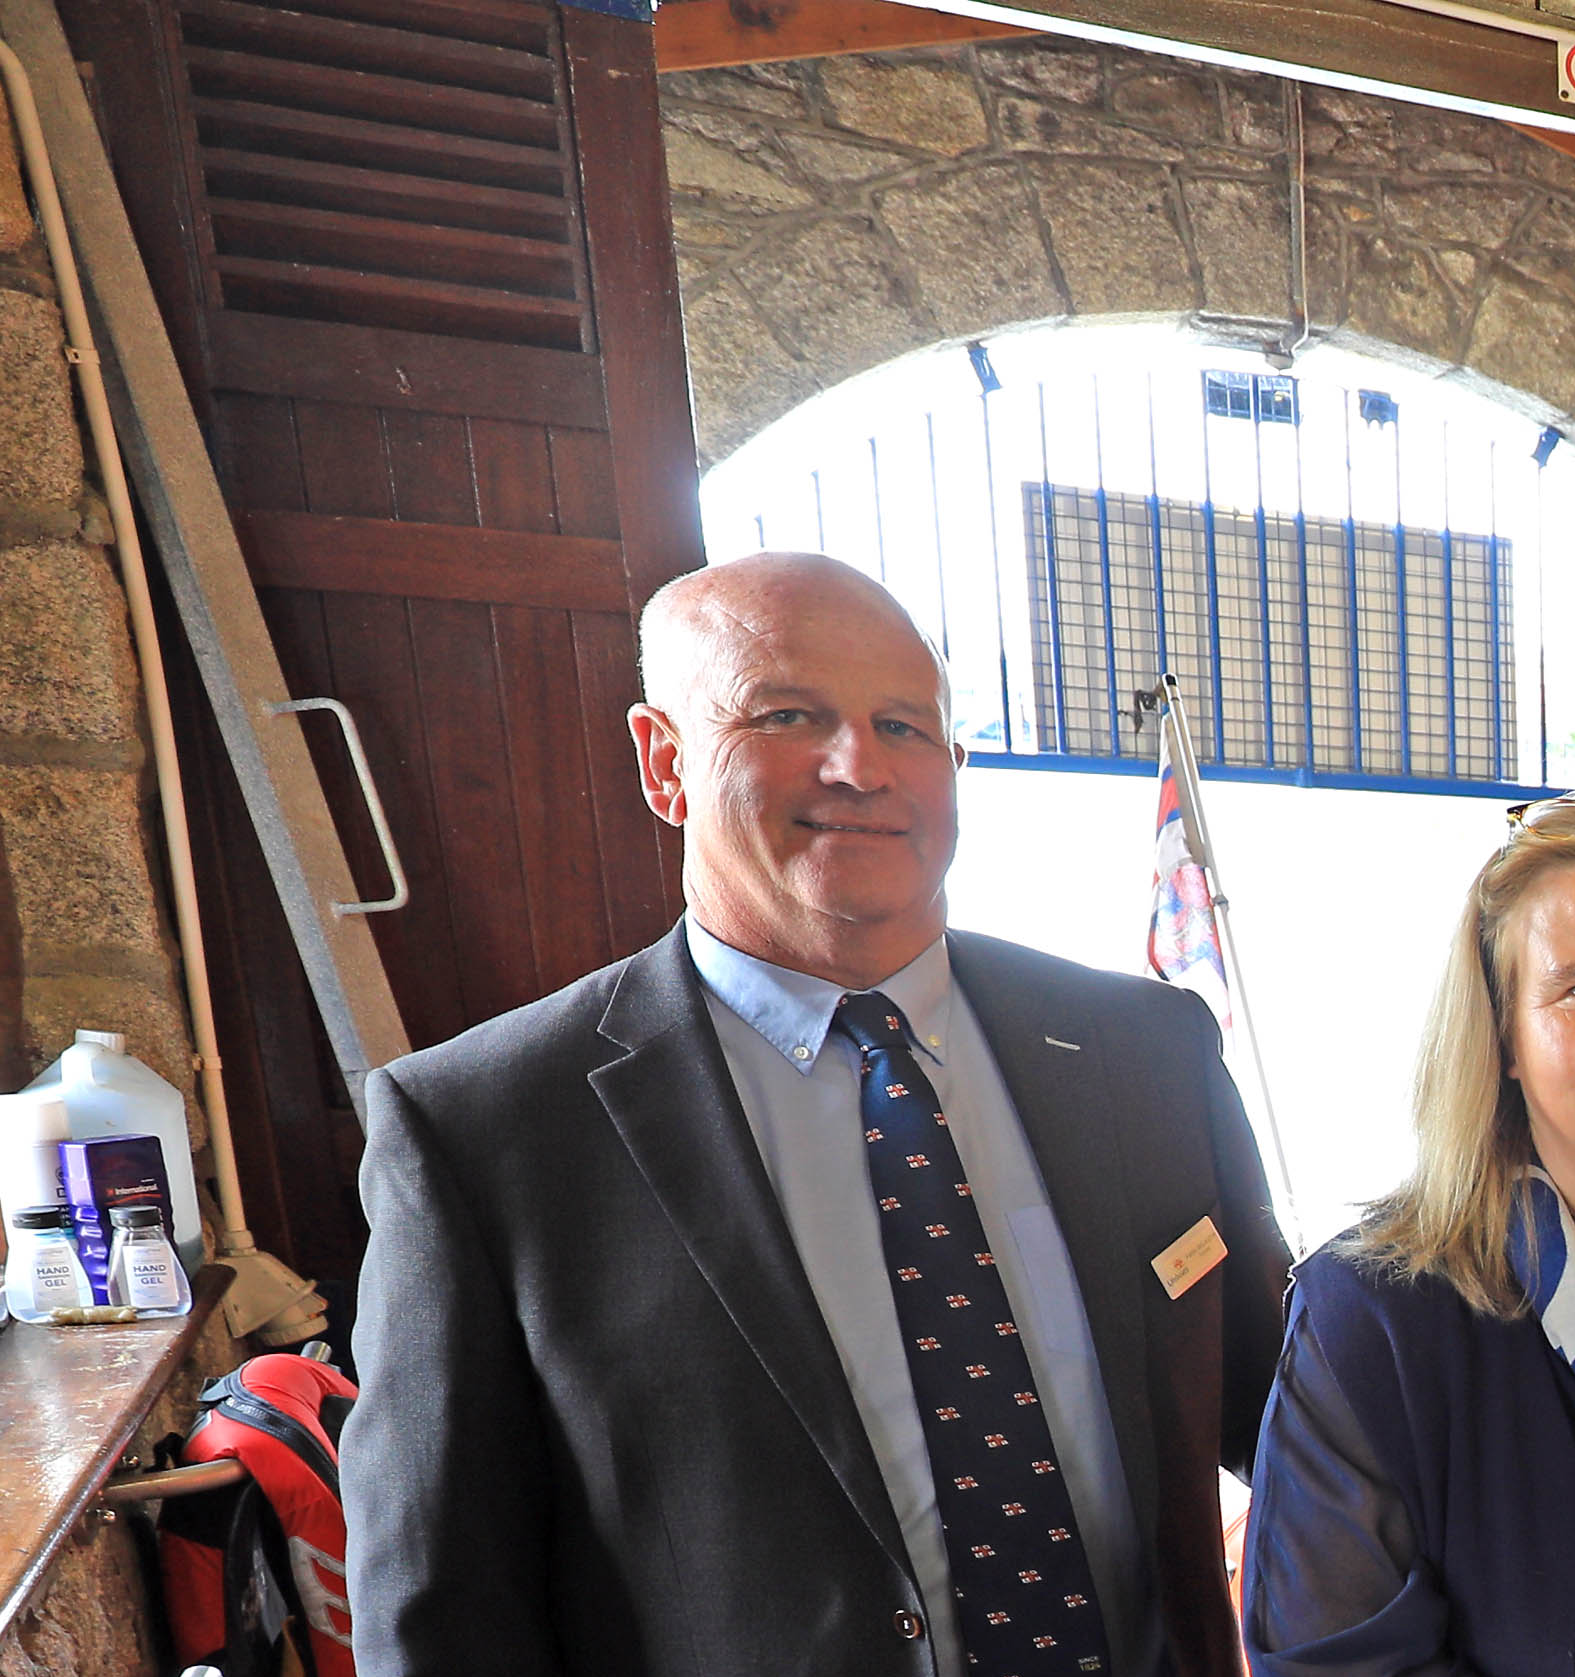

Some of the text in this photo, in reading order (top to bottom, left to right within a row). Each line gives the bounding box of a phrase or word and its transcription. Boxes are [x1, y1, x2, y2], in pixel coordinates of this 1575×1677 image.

[36, 1266, 70, 1275] HAND
[133, 1264, 166, 1273] HAND
[44, 1279, 67, 1287] GEL
[140, 1277, 163, 1285] GEL
